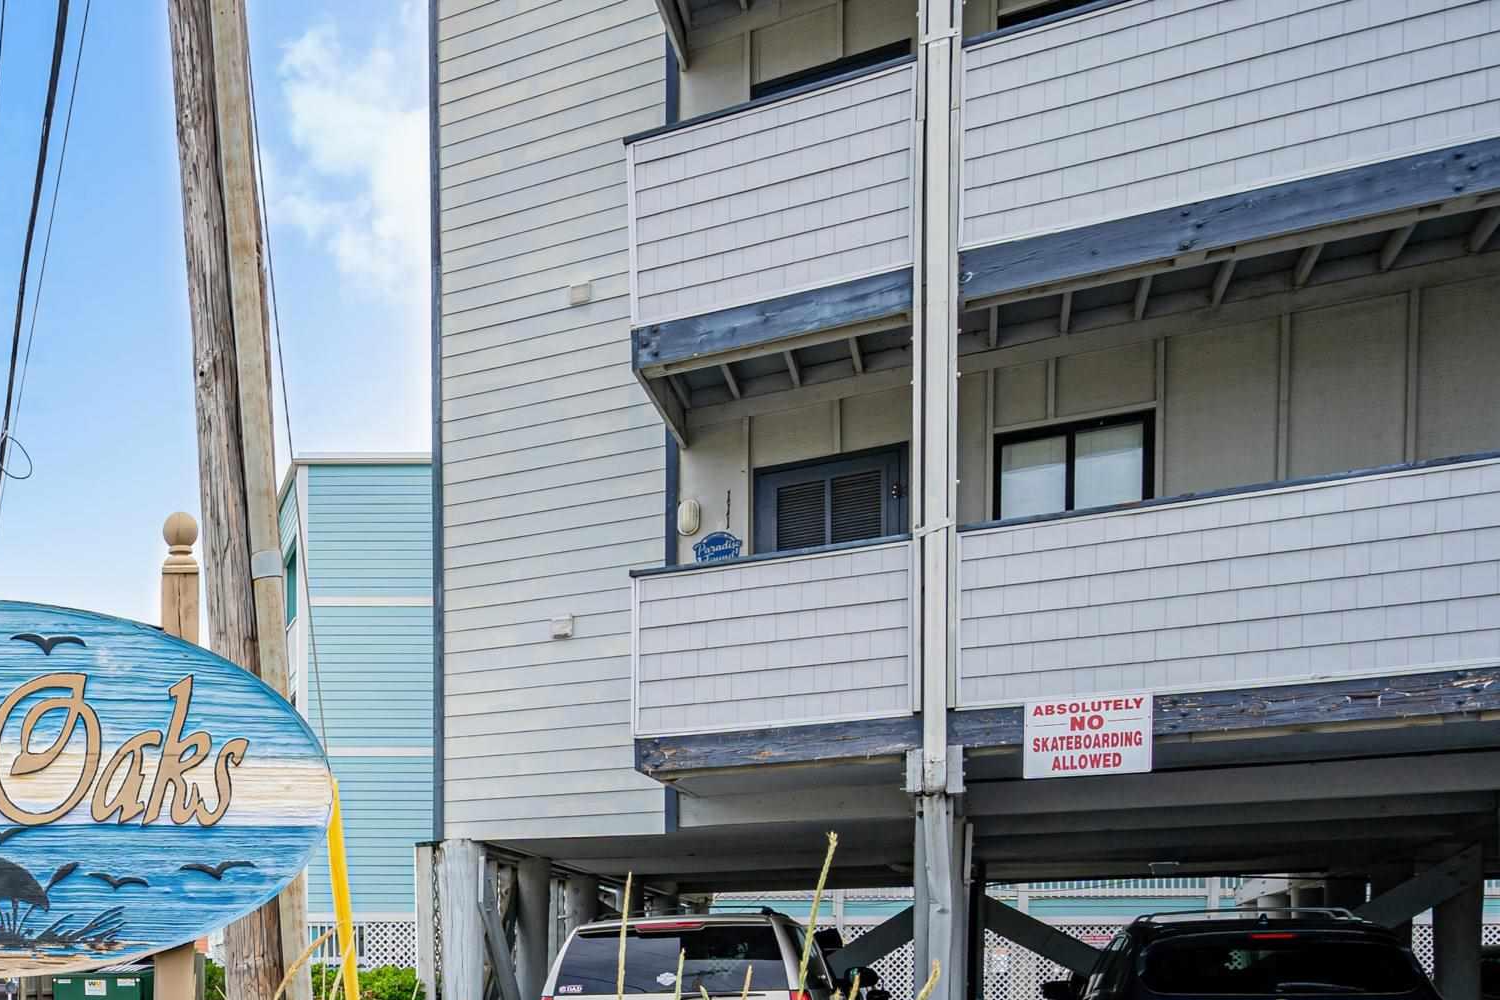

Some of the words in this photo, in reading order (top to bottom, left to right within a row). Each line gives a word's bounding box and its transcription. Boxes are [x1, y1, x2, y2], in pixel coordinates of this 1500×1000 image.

[693, 539, 742, 556] Paradise
[1033, 698, 1144, 716] ABSOLUTELY
[1070, 715, 1105, 731] NO
[1032, 731, 1143, 752] SKATEBOARDING
[1052, 752, 1122, 771] ALLOWED
